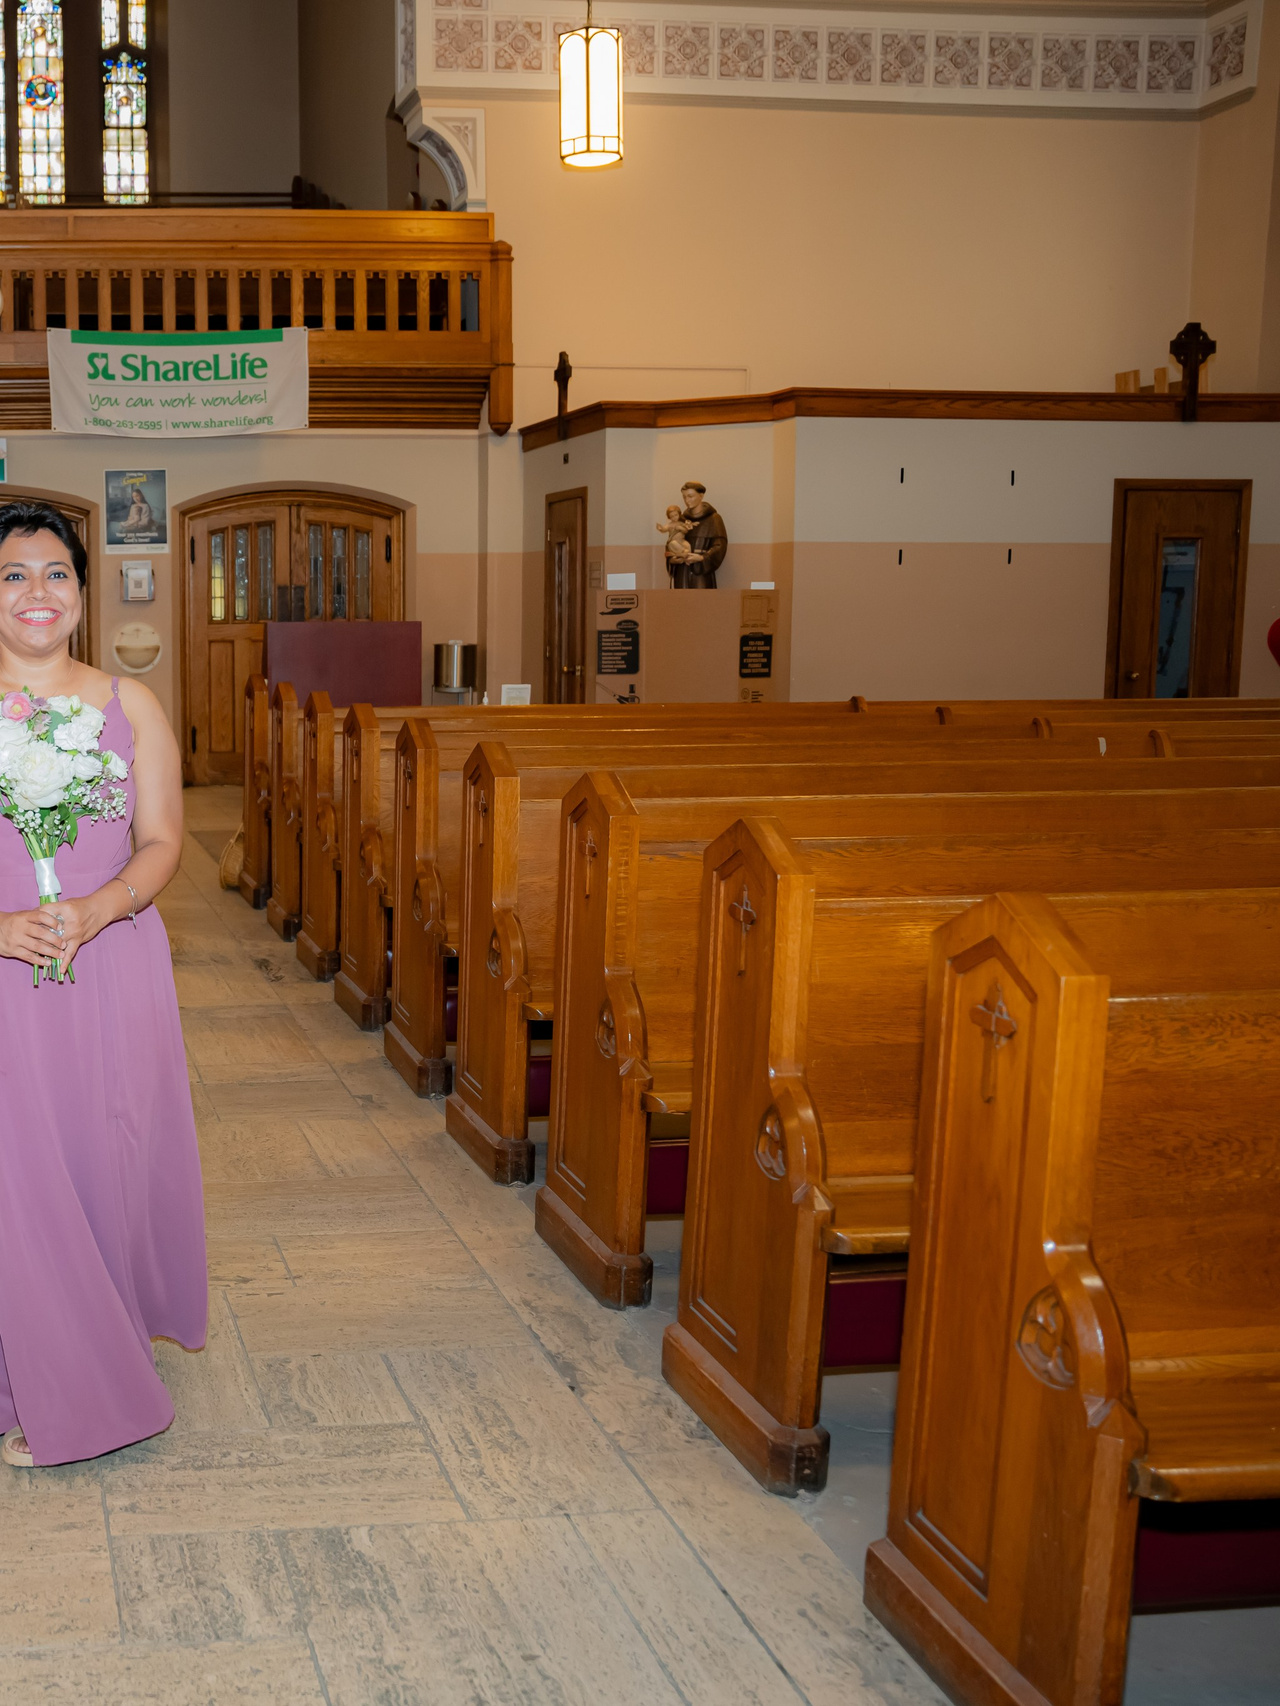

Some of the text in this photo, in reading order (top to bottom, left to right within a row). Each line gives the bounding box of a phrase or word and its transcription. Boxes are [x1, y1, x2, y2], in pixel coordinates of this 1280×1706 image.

[121, 352, 268, 382] ShareLife
[88, 390, 268, 412] You can work wonders!
[84, 415, 274, 430] 1-800-263-2595 www.sharelife.org
[123, 474, 147, 486] Gospel
